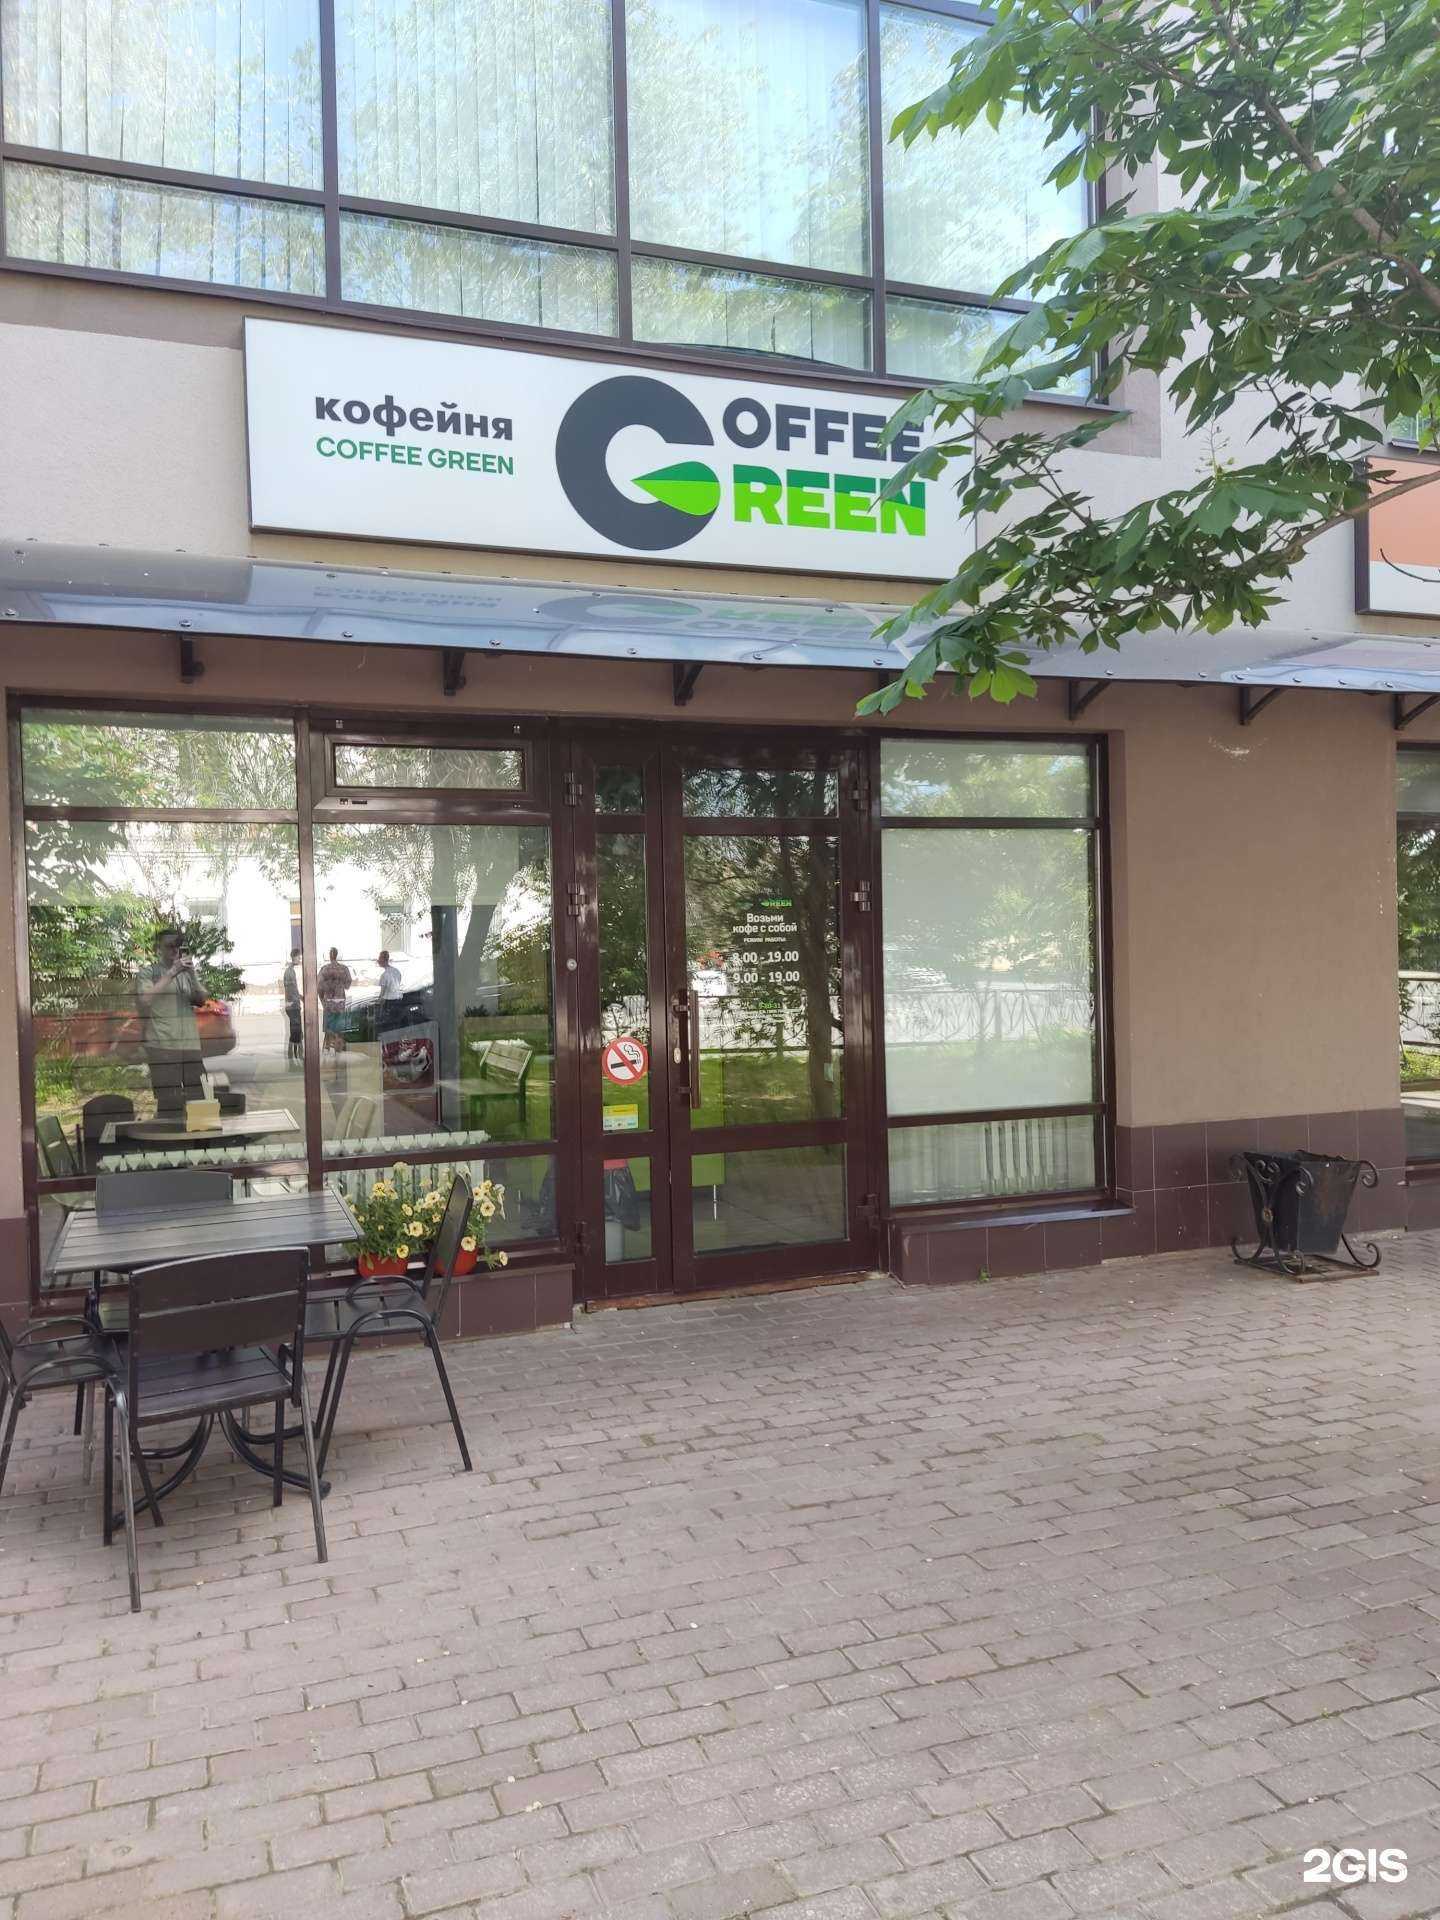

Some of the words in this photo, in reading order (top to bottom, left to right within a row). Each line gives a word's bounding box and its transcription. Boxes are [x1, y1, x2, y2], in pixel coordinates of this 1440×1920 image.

[315, 395, 513, 441] кофейня
[316, 436, 423, 466] COFFEE
[427, 448, 514, 475] GREEN
[746, 913, 784, 923] Возьми
[732, 923, 759, 935] кофе
[760, 925, 767, 933] с
[768, 922, 798, 933] собой
[767, 950, 799, 962] 19.00
[732, 972, 759, 983] 9.00
[768, 970, 800, 983] 19.00
